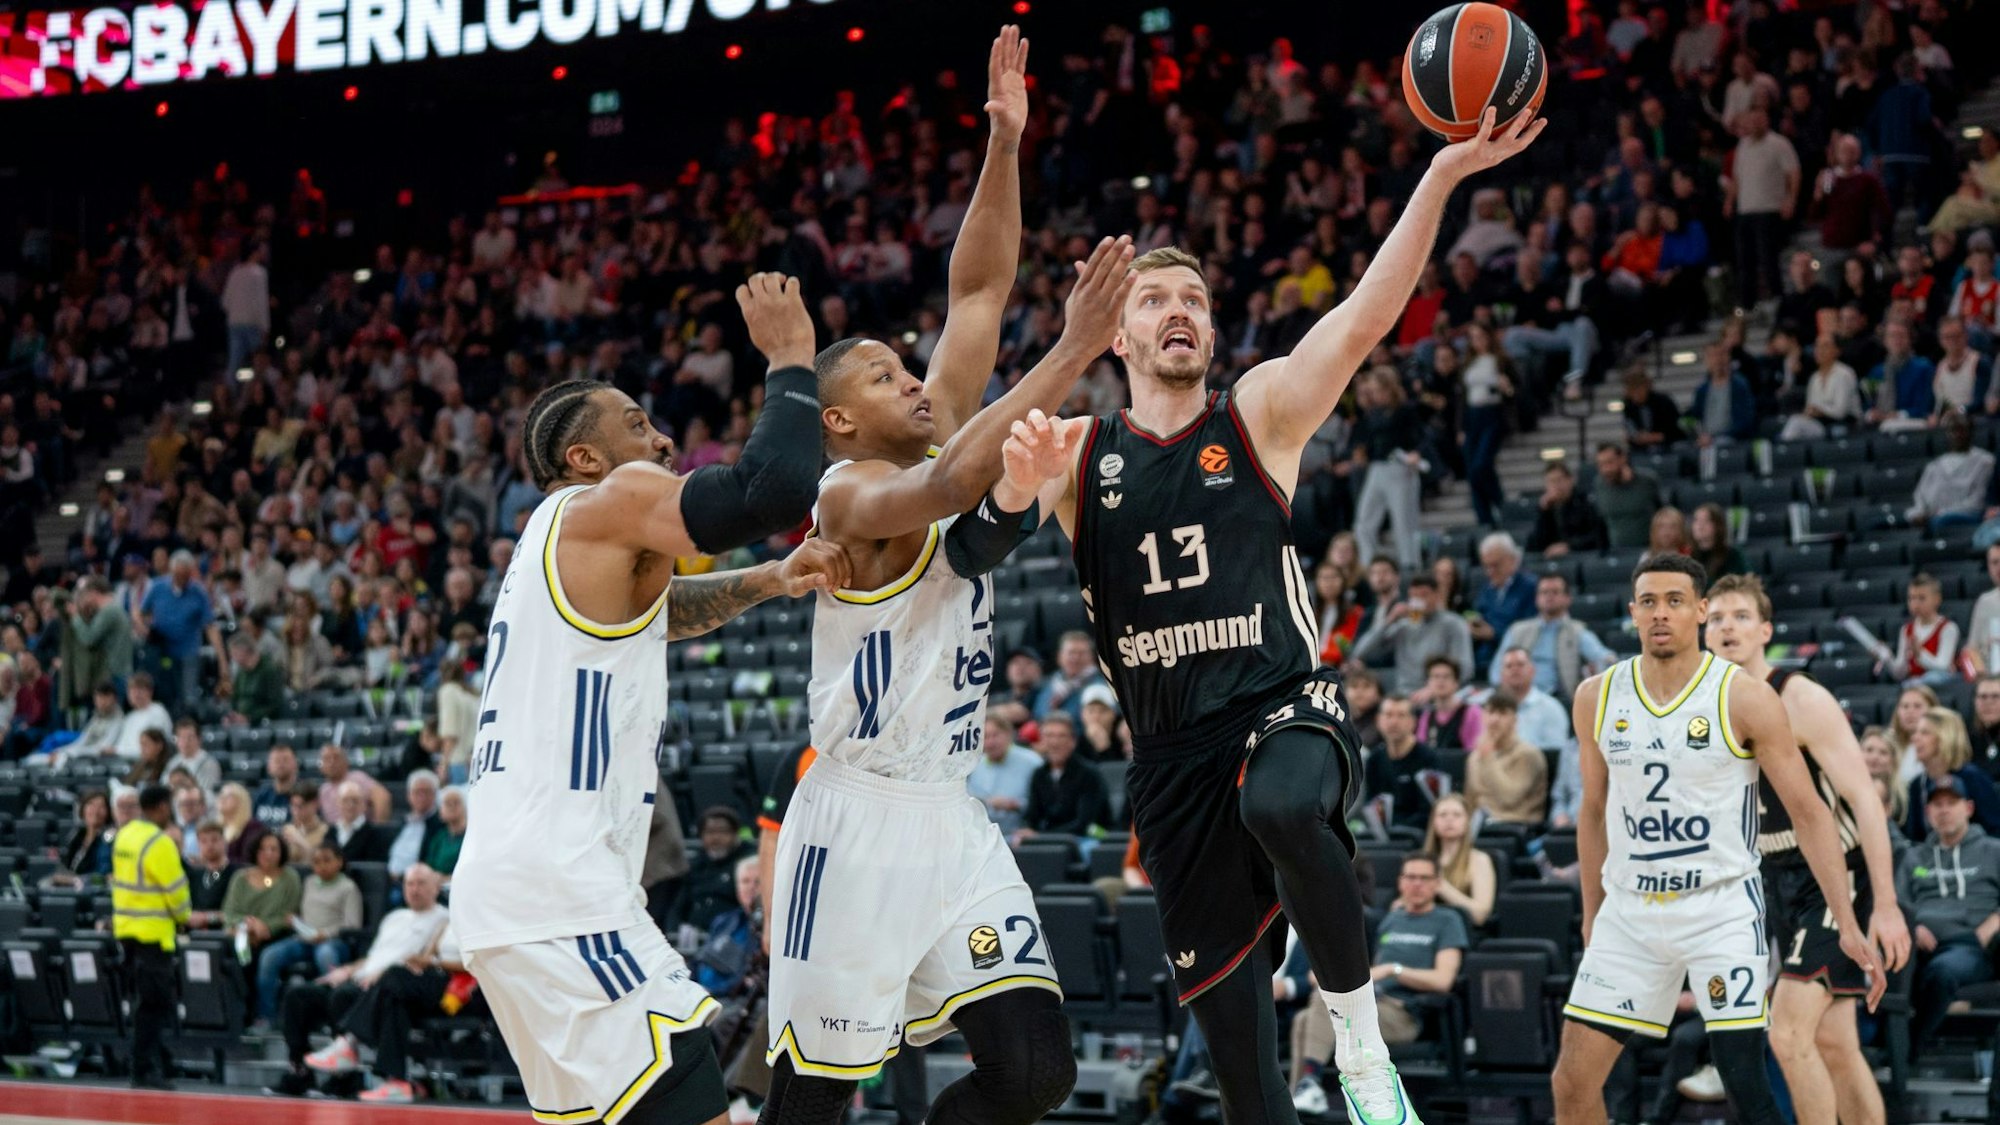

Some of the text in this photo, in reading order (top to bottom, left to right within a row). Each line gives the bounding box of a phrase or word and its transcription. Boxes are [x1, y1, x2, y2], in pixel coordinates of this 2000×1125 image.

[1137, 523, 1210, 595] 13
[1117, 602, 1263, 668] siegmund
[1609, 738, 1631, 749] beko
[1643, 762, 1670, 802] 2
[1623, 806, 1711, 842] beko
[1637, 869, 1702, 892] misli
[1005, 914, 1056, 968] 2
[1730, 966, 1757, 1008] 2
[820, 1016, 850, 1032] YKT
